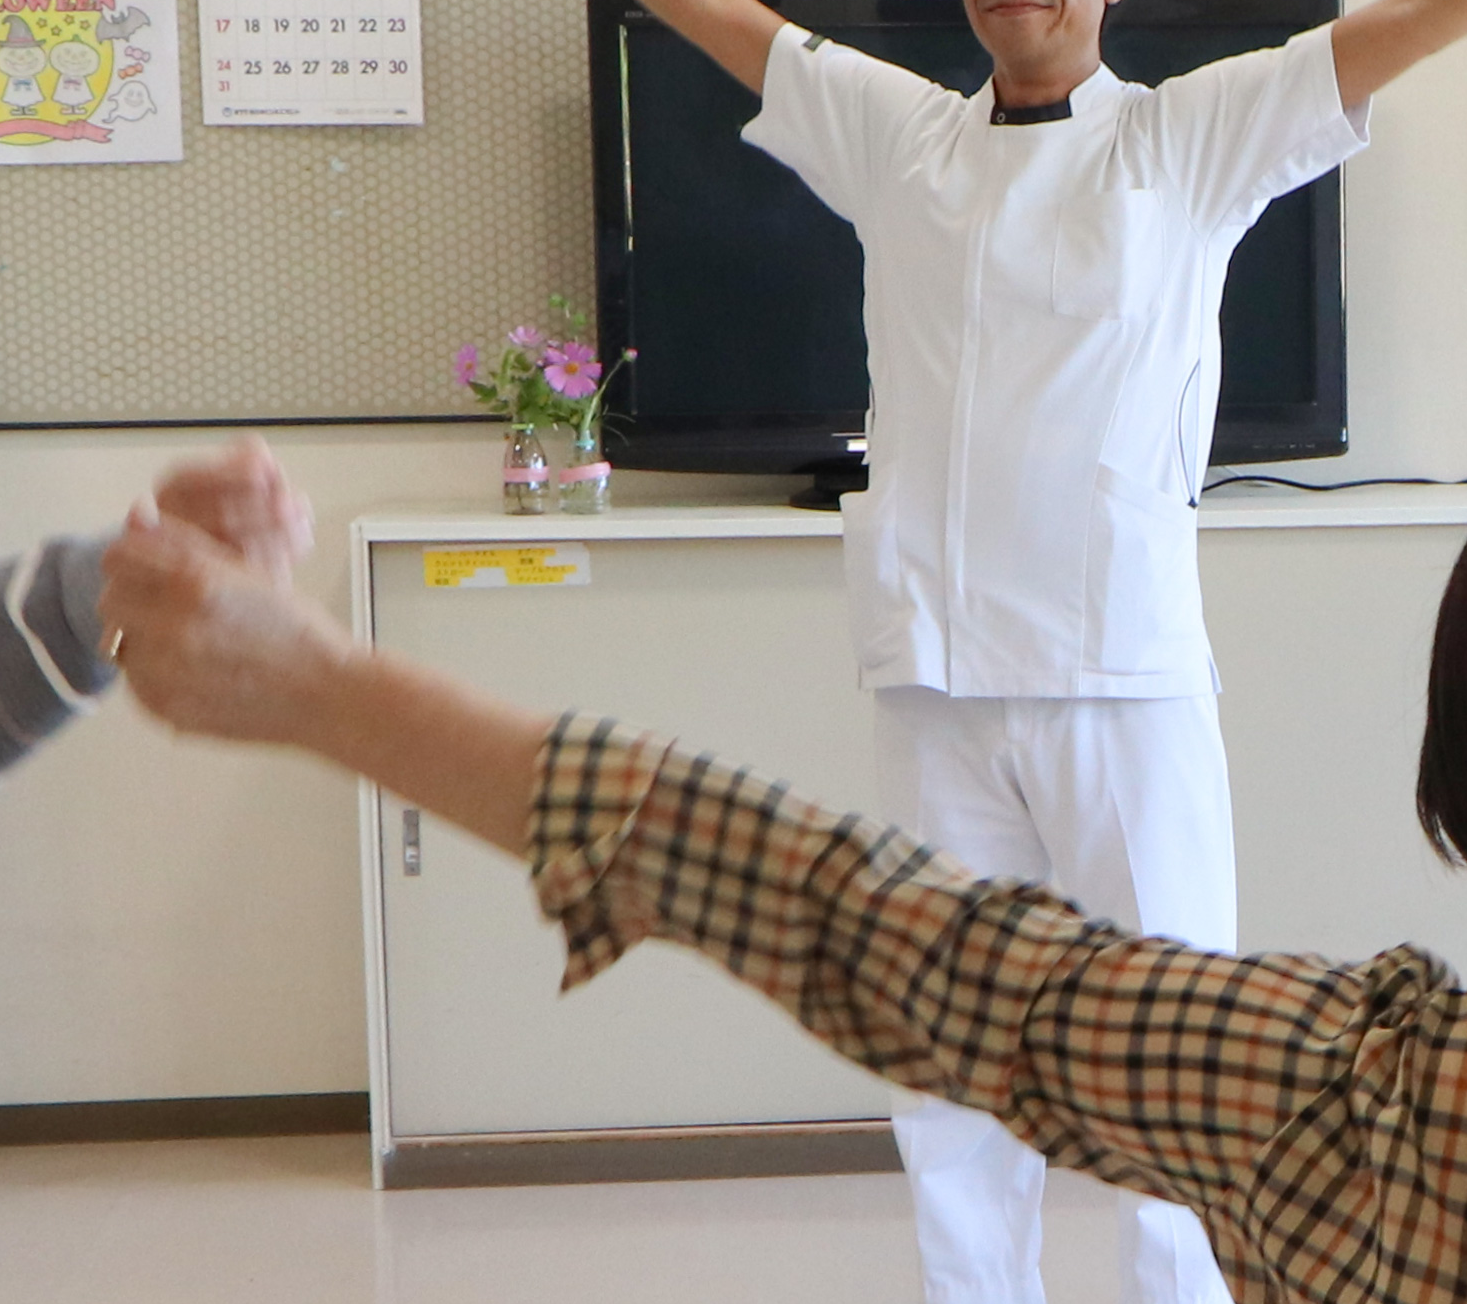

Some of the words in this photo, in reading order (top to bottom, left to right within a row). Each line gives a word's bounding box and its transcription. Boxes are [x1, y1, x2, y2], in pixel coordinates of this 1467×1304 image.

[216, 19, 231, 33] 17
[244, 18, 261, 34] 18
[273, 18, 290, 33] 19
[301, 18, 320, 33] 20
[330, 18, 346, 34] 21
[358, 18, 377, 33] 22
[387, 18, 406, 33] 23
[217, 60, 231, 71] 24
[244, 60, 262, 75] 25
[273, 60, 292, 75] 26
[301, 60, 320, 75] 27
[331, 60, 349, 75] 28
[360, 60, 379, 75] 29
[389, 59, 408, 75] 30
[219, 80, 230, 92] 31
